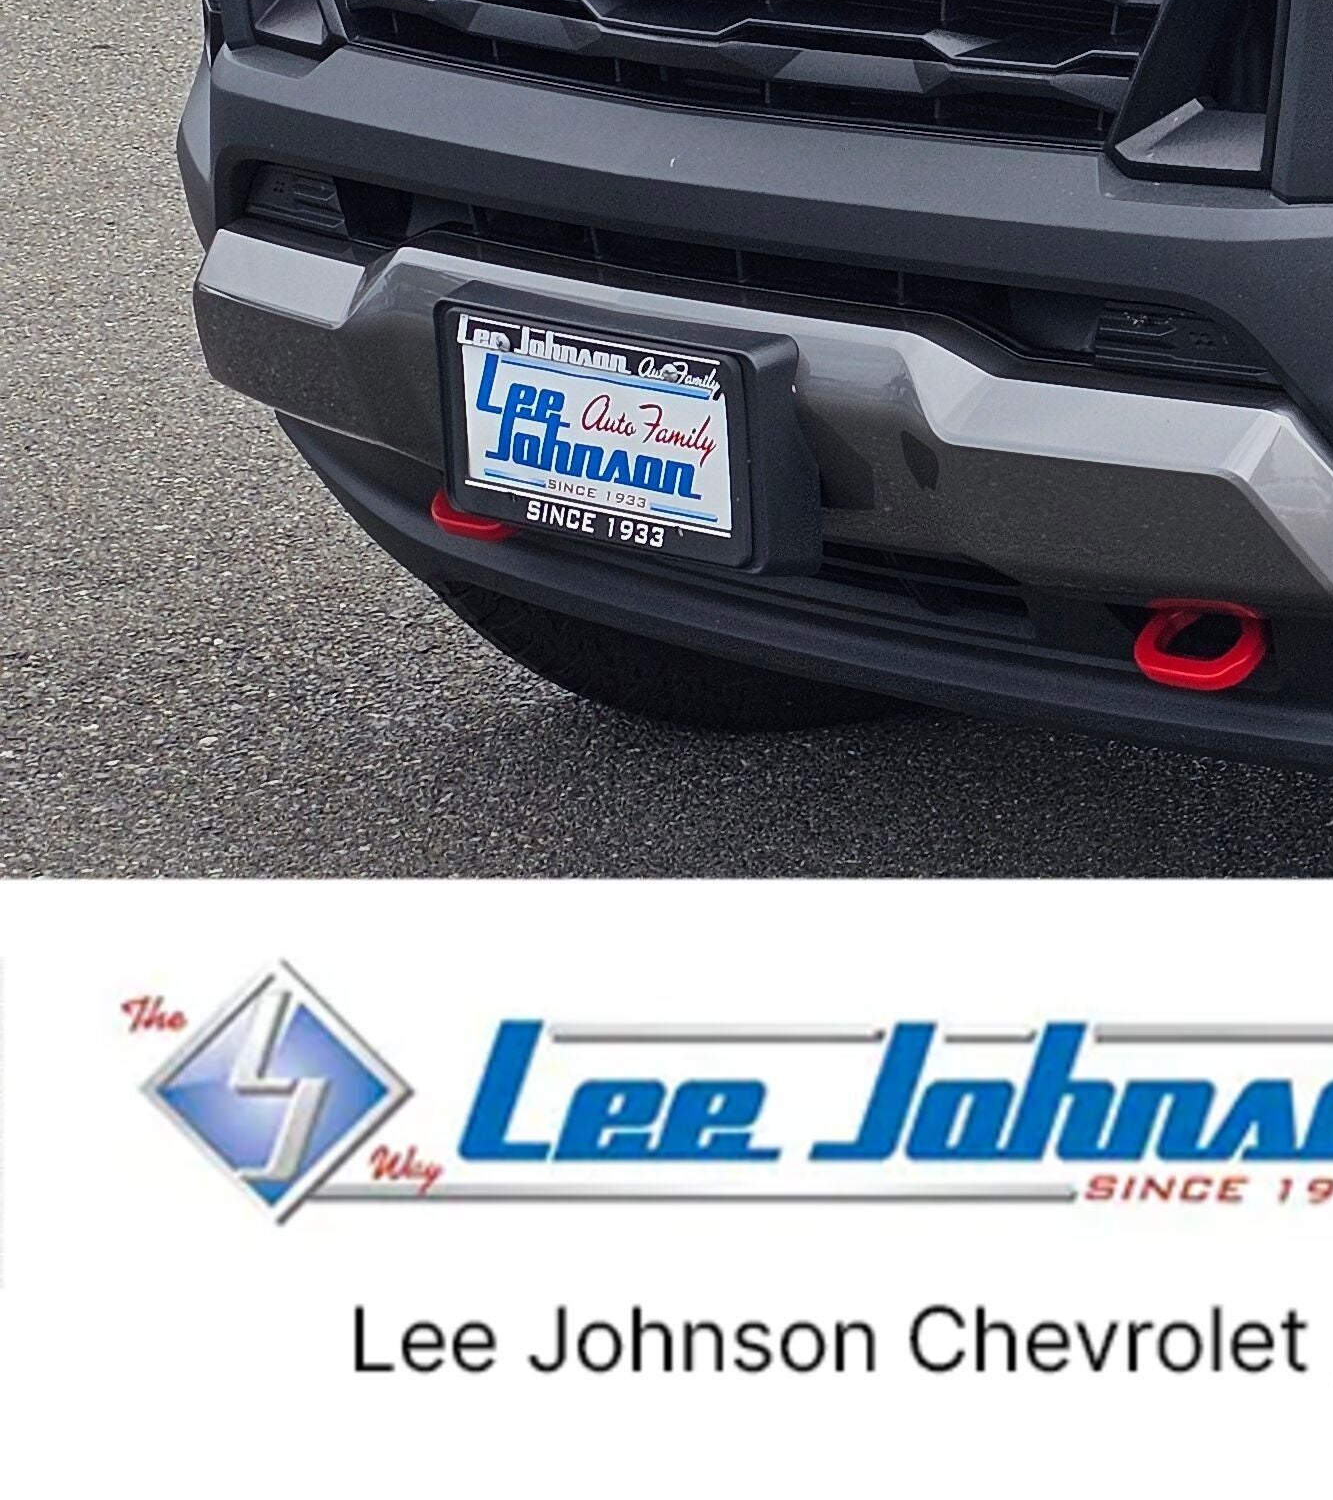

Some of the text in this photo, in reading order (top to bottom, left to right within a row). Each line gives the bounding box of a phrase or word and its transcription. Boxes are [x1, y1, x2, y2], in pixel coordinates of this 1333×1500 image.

[476, 353, 571, 428] Lee
[514, 326, 632, 375] Johnson
[673, 361, 722, 400] Family
[485, 382, 703, 500] Johnson
[582, 394, 718, 467] Auto Family
[526, 502, 666, 549] SINCE 1933
[546, 478, 649, 510] SINCE 1933
